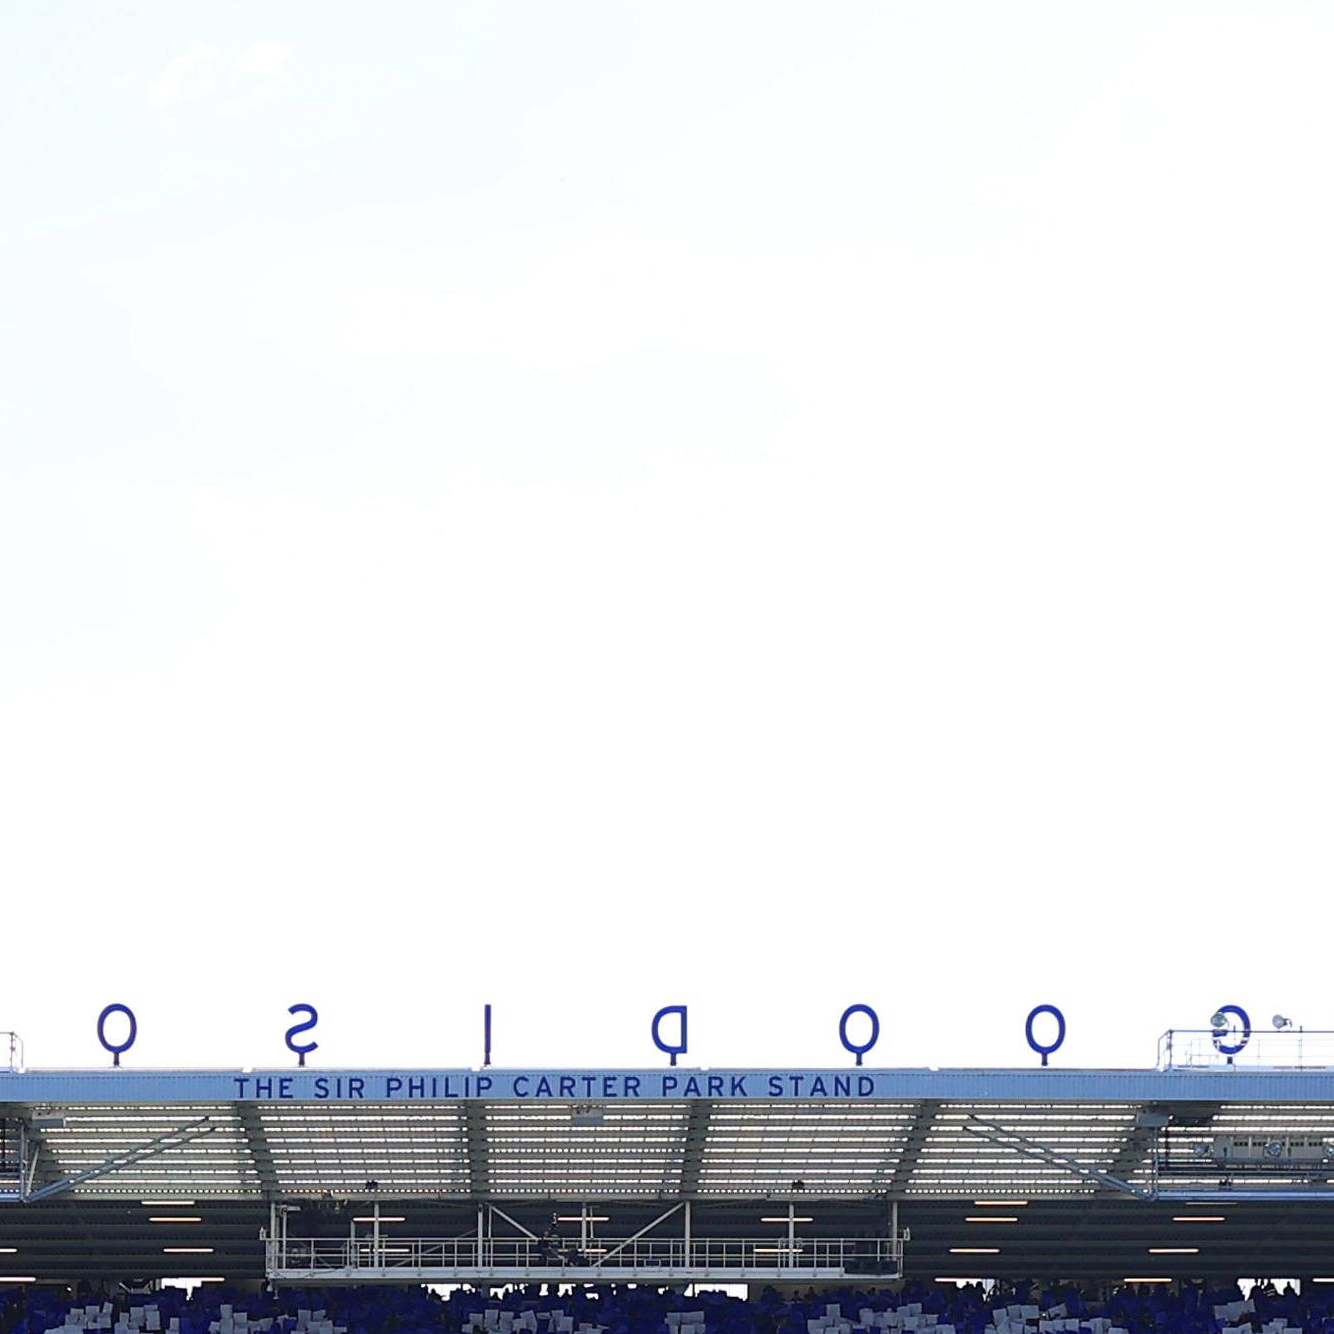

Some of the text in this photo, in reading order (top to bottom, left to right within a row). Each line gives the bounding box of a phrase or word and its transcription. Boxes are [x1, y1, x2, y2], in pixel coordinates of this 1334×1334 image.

[233, 1076, 875, 1100] THE SIR PHILIP CARTER PARK STAND
